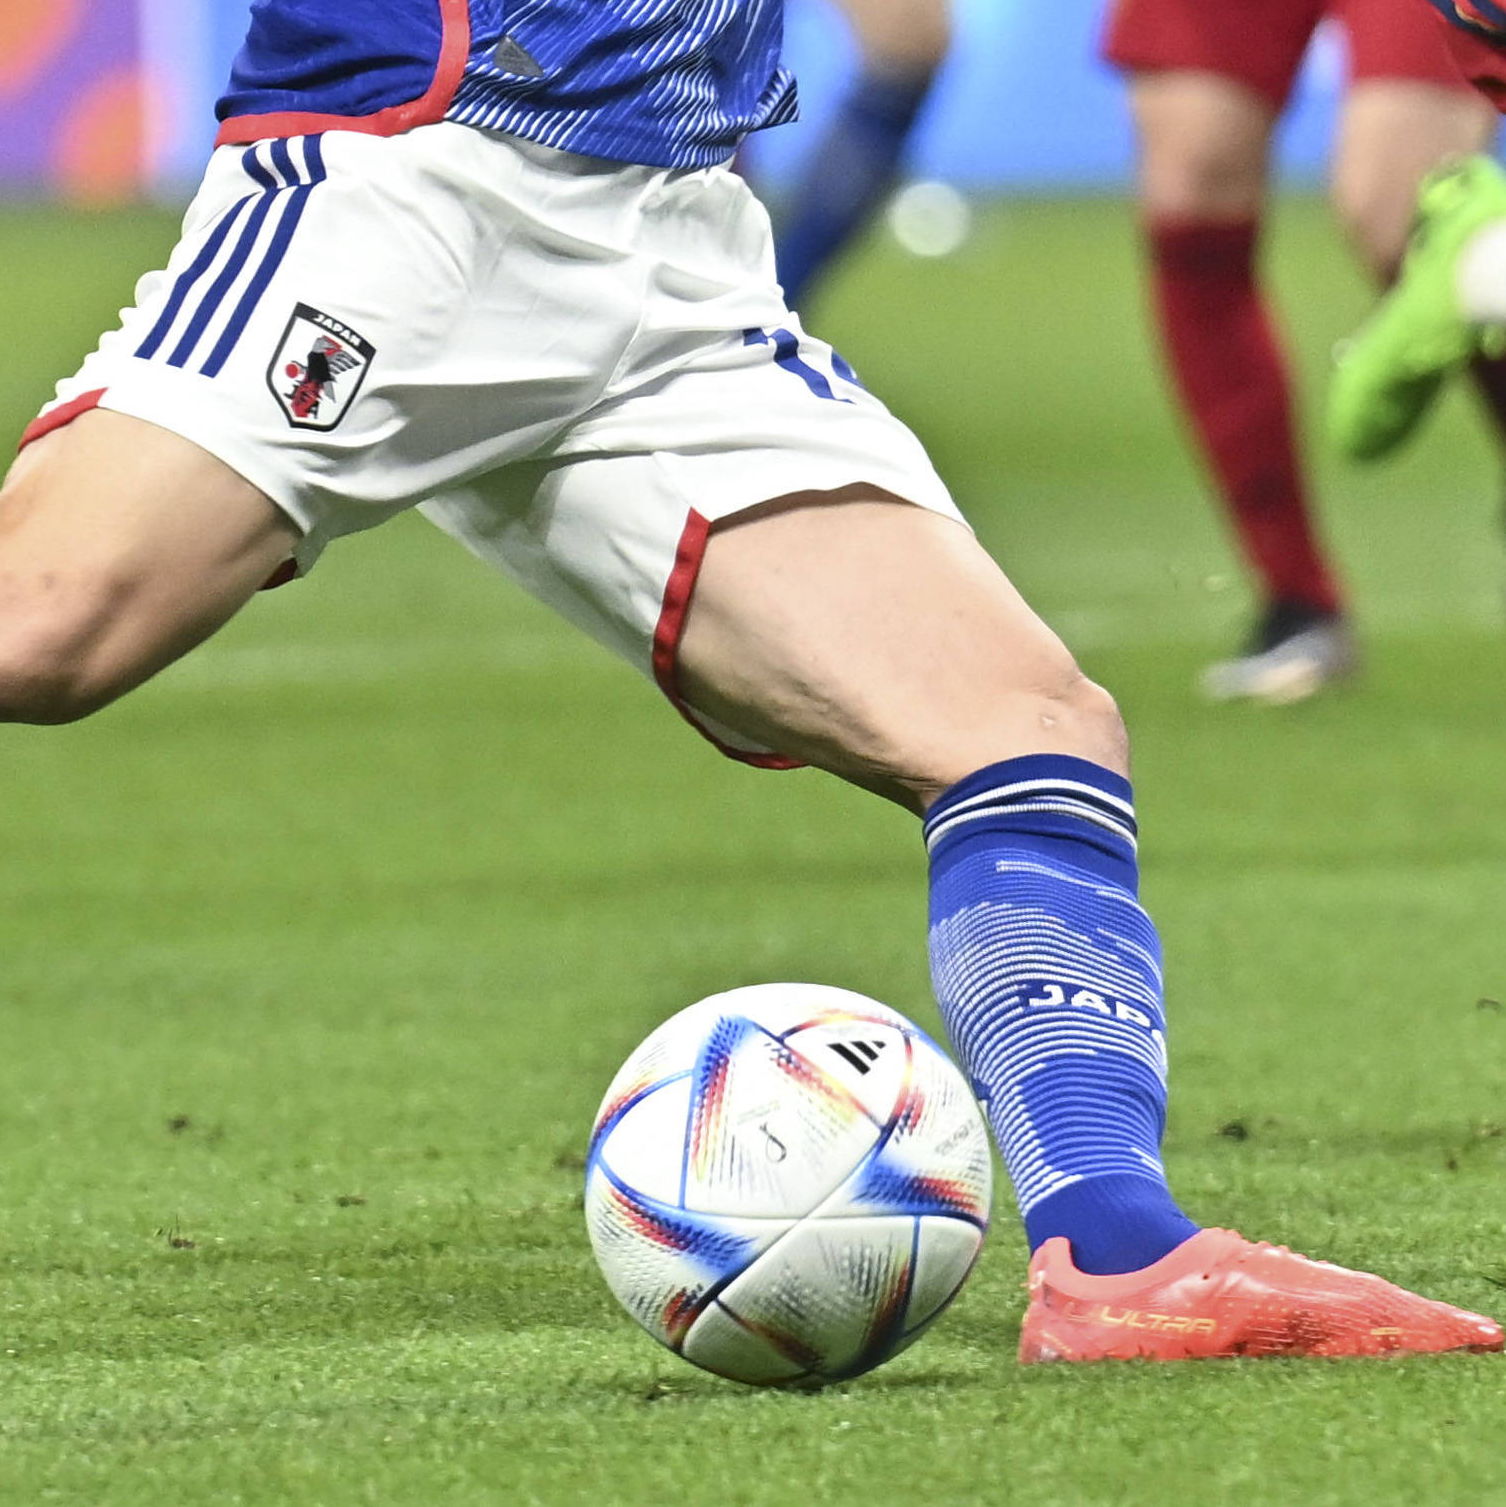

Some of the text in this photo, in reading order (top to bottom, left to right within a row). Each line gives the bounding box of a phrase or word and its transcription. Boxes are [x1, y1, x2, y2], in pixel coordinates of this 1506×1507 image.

[313, 313, 362, 347] JAPAN
[742, 326, 866, 406] 1
[1029, 984, 1166, 1046] JAP
[1100, 1305, 1218, 1336] ULTRA
